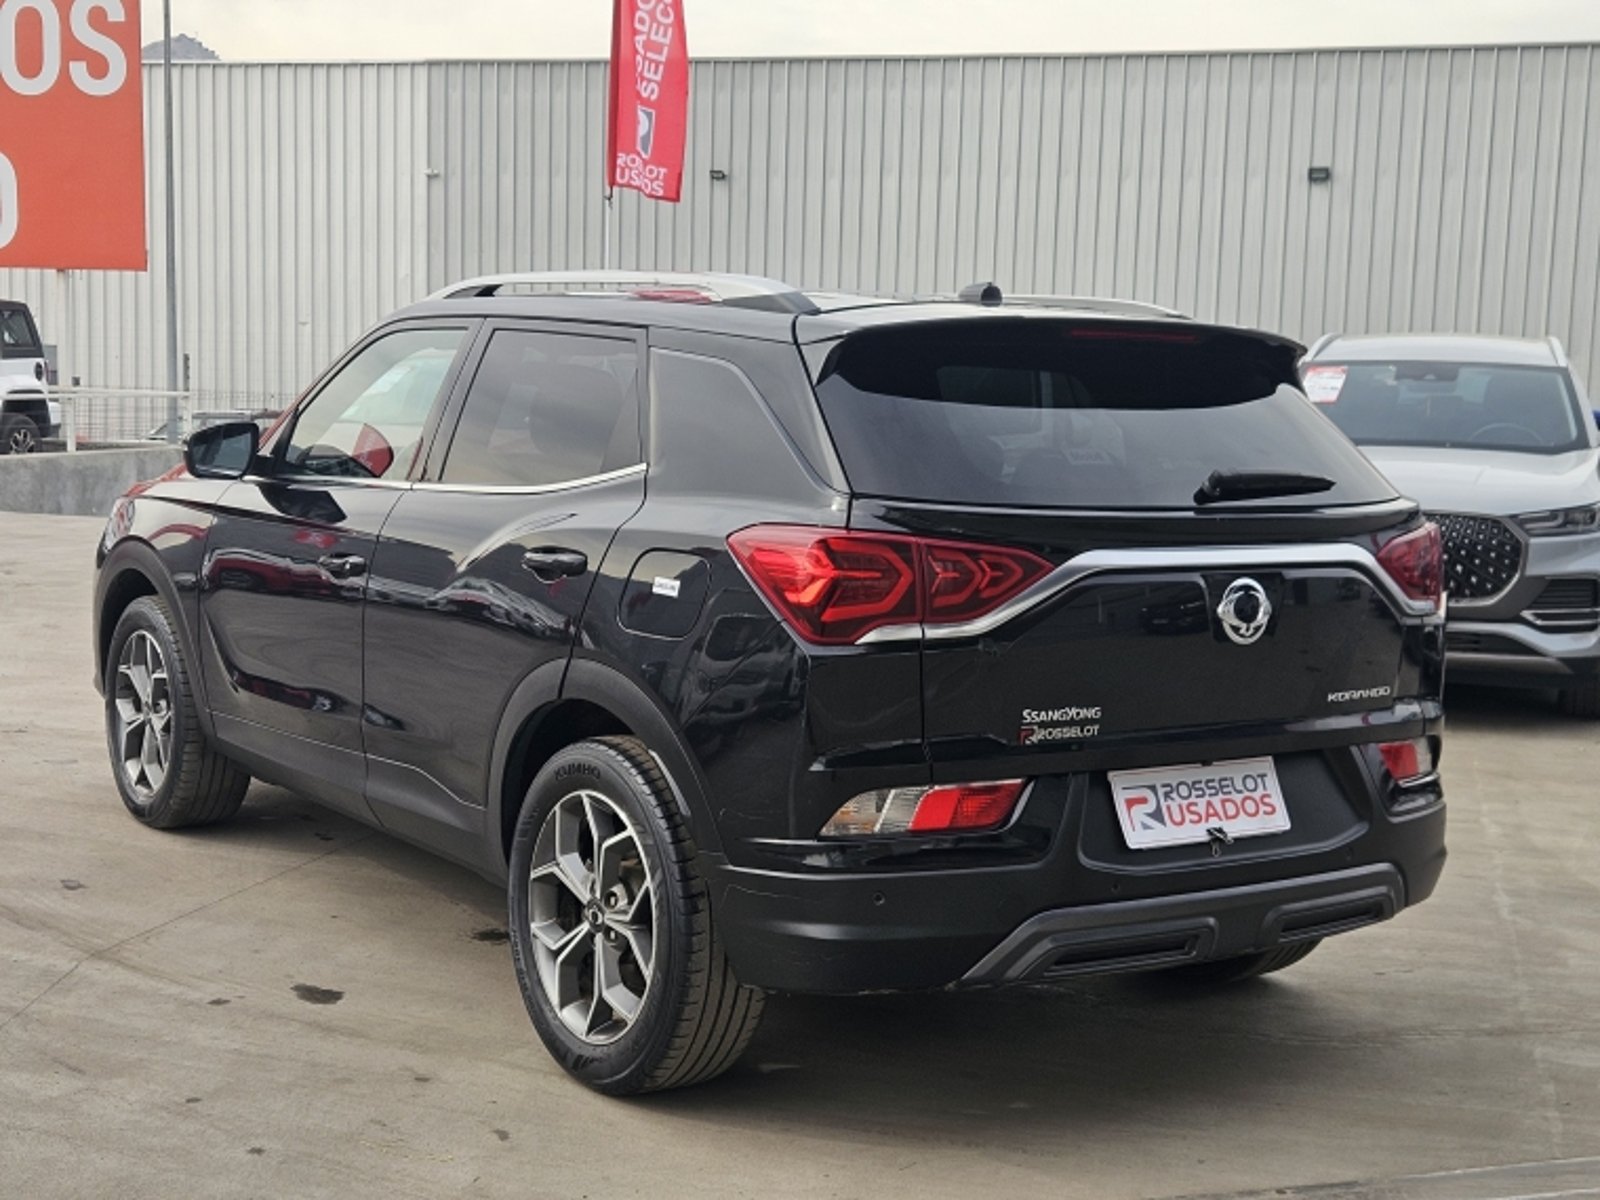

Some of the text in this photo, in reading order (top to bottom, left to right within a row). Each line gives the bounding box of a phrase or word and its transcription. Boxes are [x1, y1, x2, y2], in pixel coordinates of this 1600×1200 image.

[1326, 686, 1391, 703] KORANDO
[1160, 774, 1268, 802] ROSSELOT
[1165, 794, 1277, 826] USADOS
